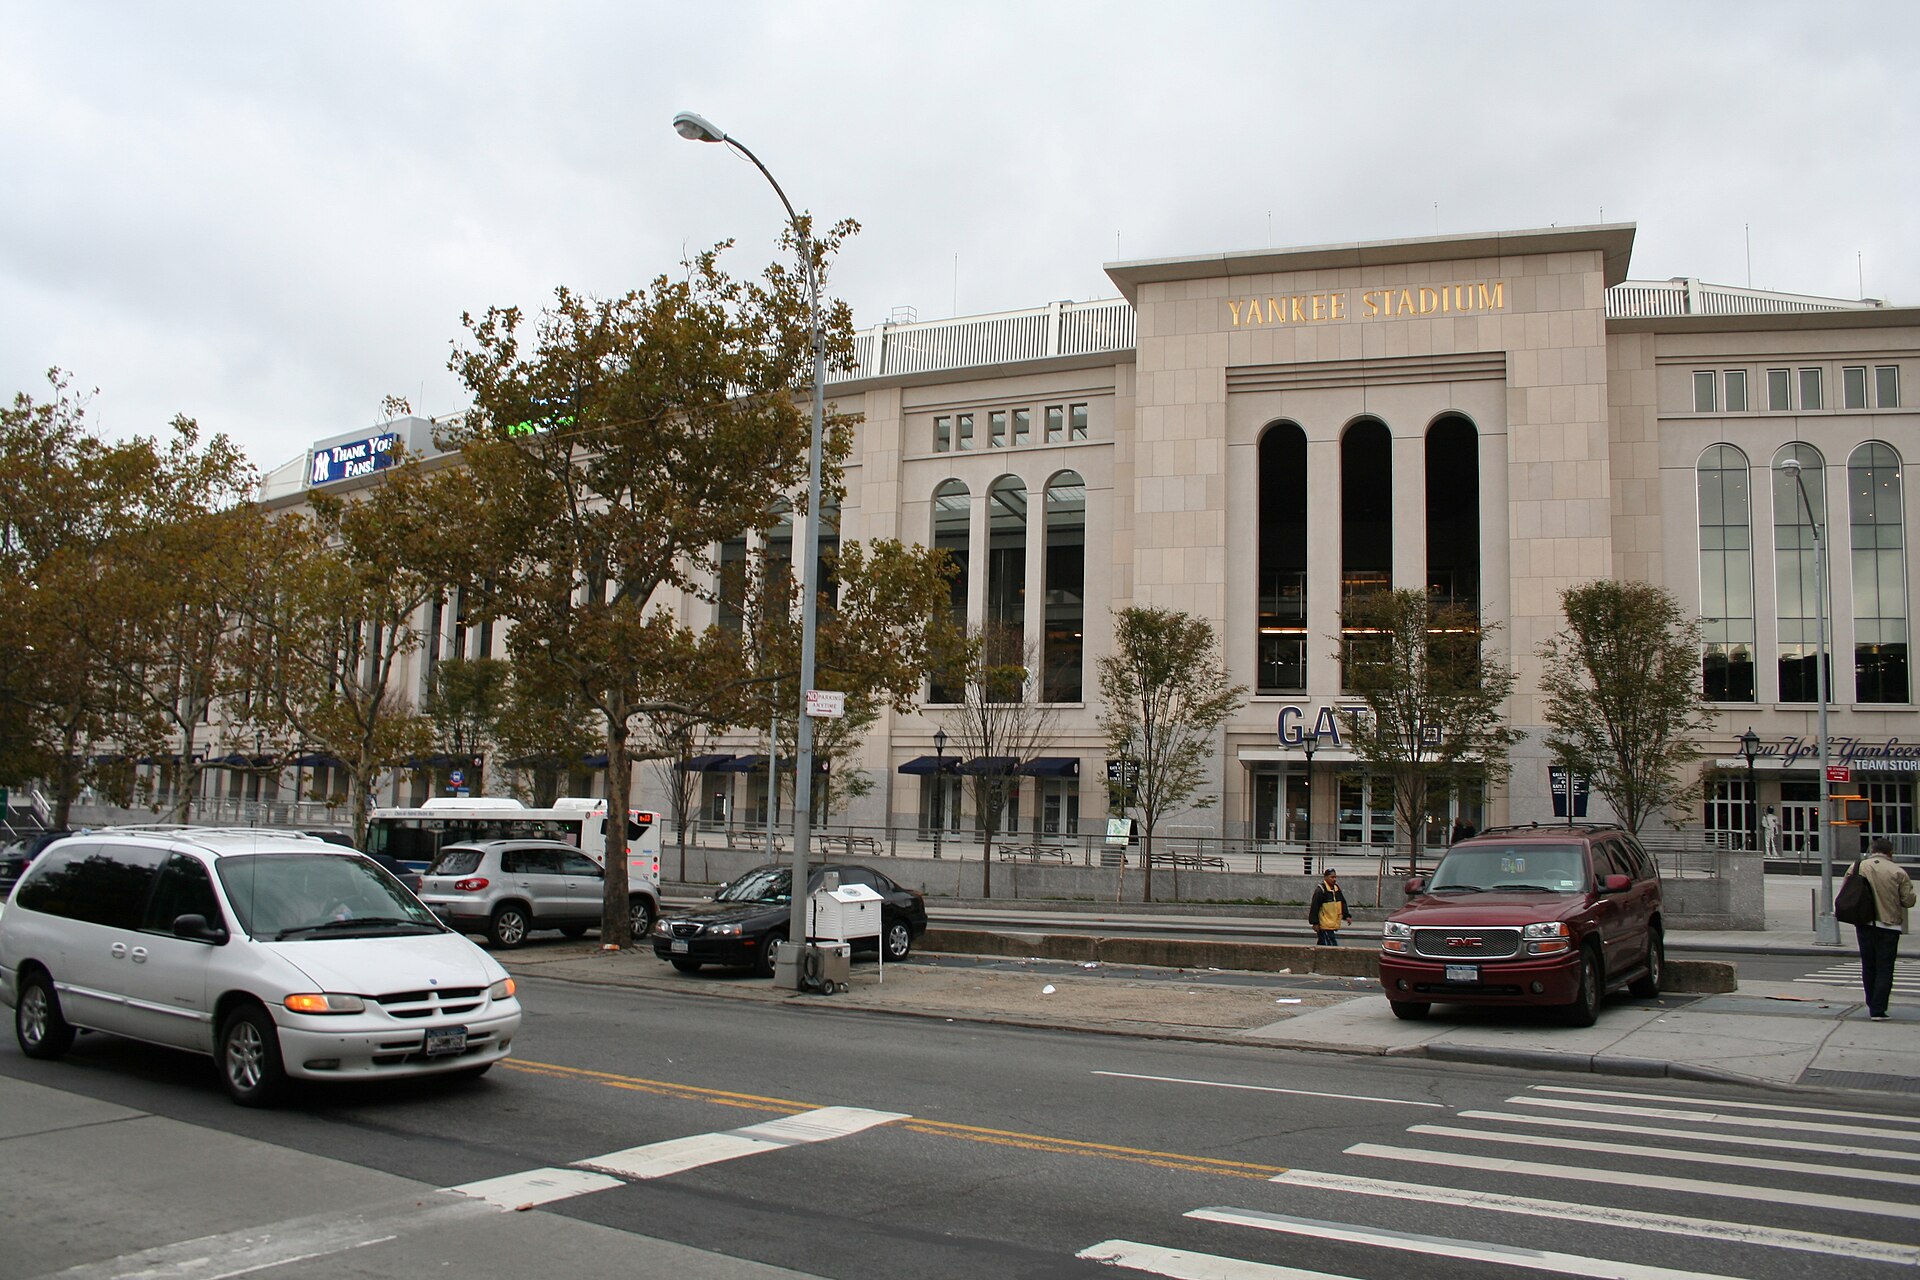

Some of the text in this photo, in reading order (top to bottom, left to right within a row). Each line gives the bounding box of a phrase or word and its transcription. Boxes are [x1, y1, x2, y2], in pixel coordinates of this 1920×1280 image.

[1228, 282, 1504, 326] YANKEE STADIUM
[807, 692, 817, 701] NO
[1277, 704, 1402, 747] GAT
[1837, 736, 1920, 767] Yankees
[1855, 759, 1889, 770] TEAM
[1446, 937, 1483, 947] GMC
